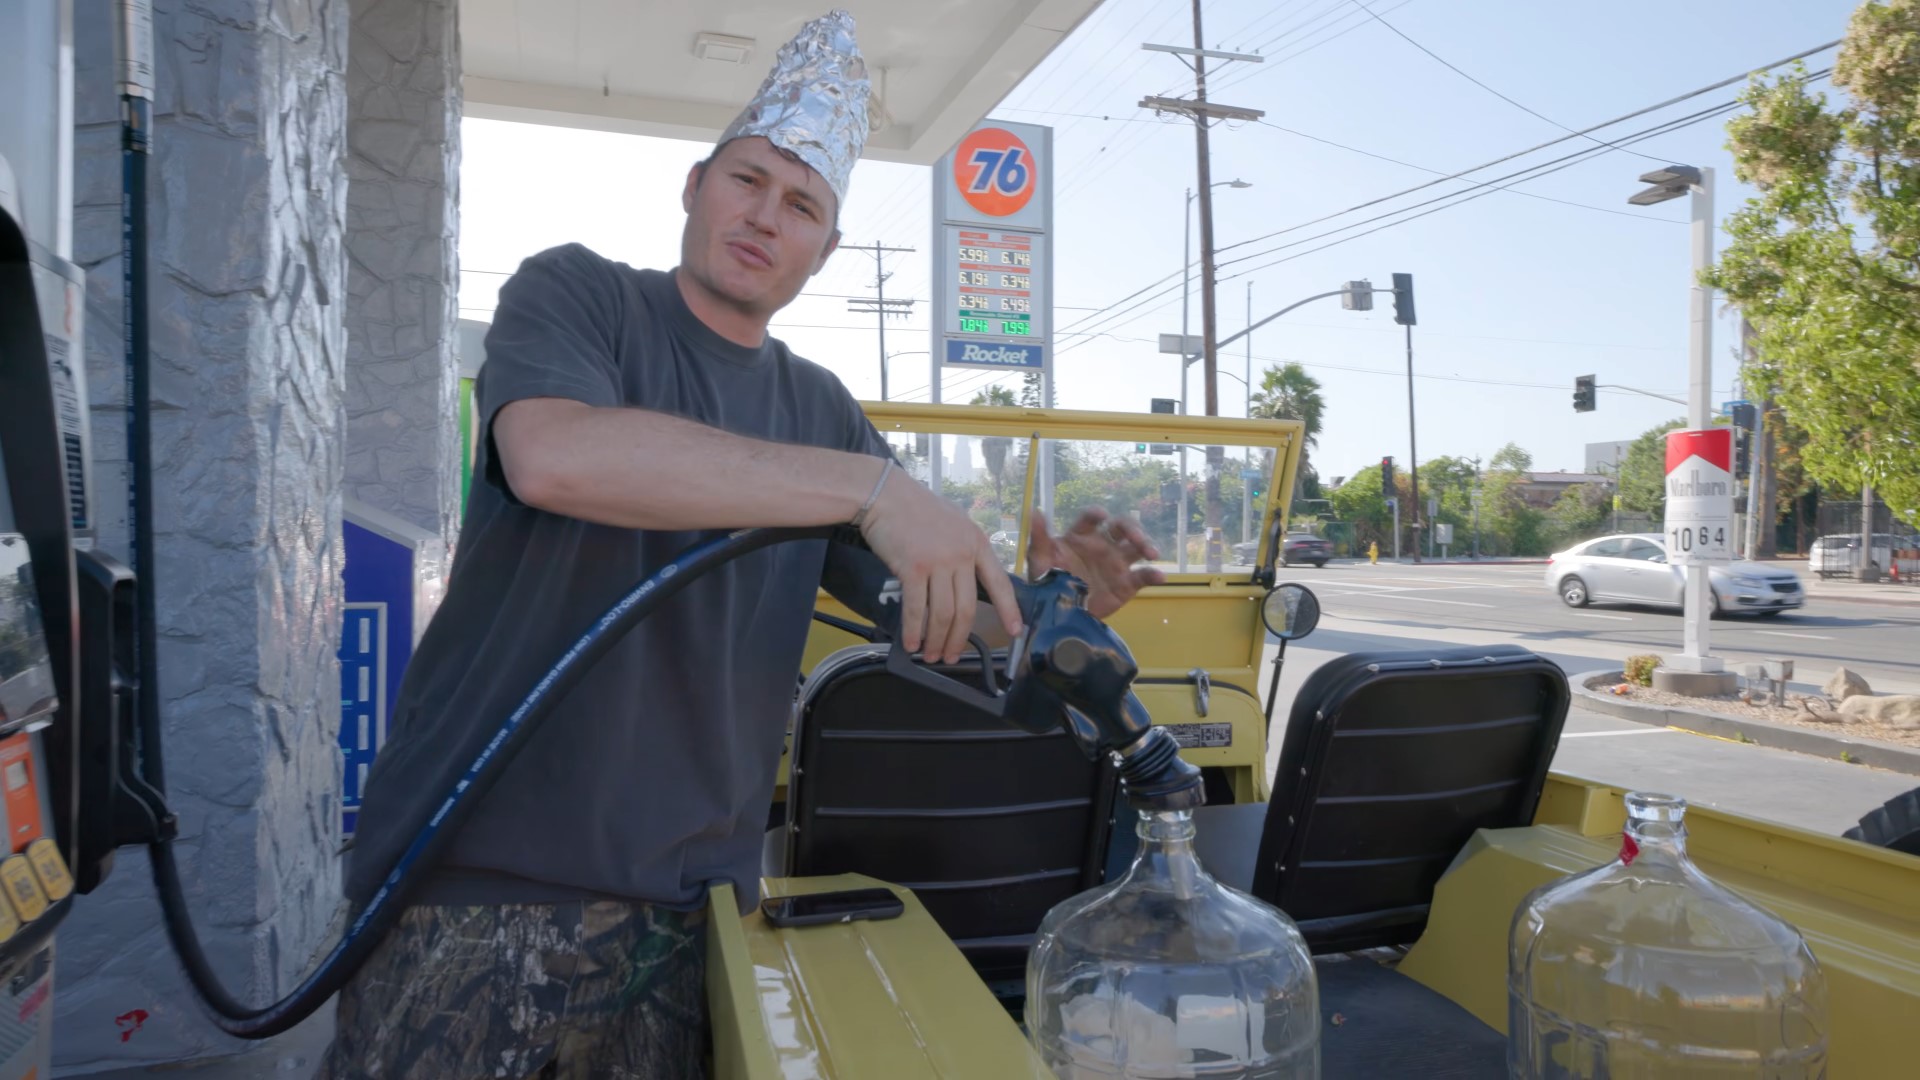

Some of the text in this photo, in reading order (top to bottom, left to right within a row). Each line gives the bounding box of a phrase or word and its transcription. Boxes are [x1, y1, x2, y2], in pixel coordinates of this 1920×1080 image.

[968, 146, 1029, 197] 76
[961, 344, 1029, 364] Rocket
[1671, 470, 1726, 496] Marlboro
